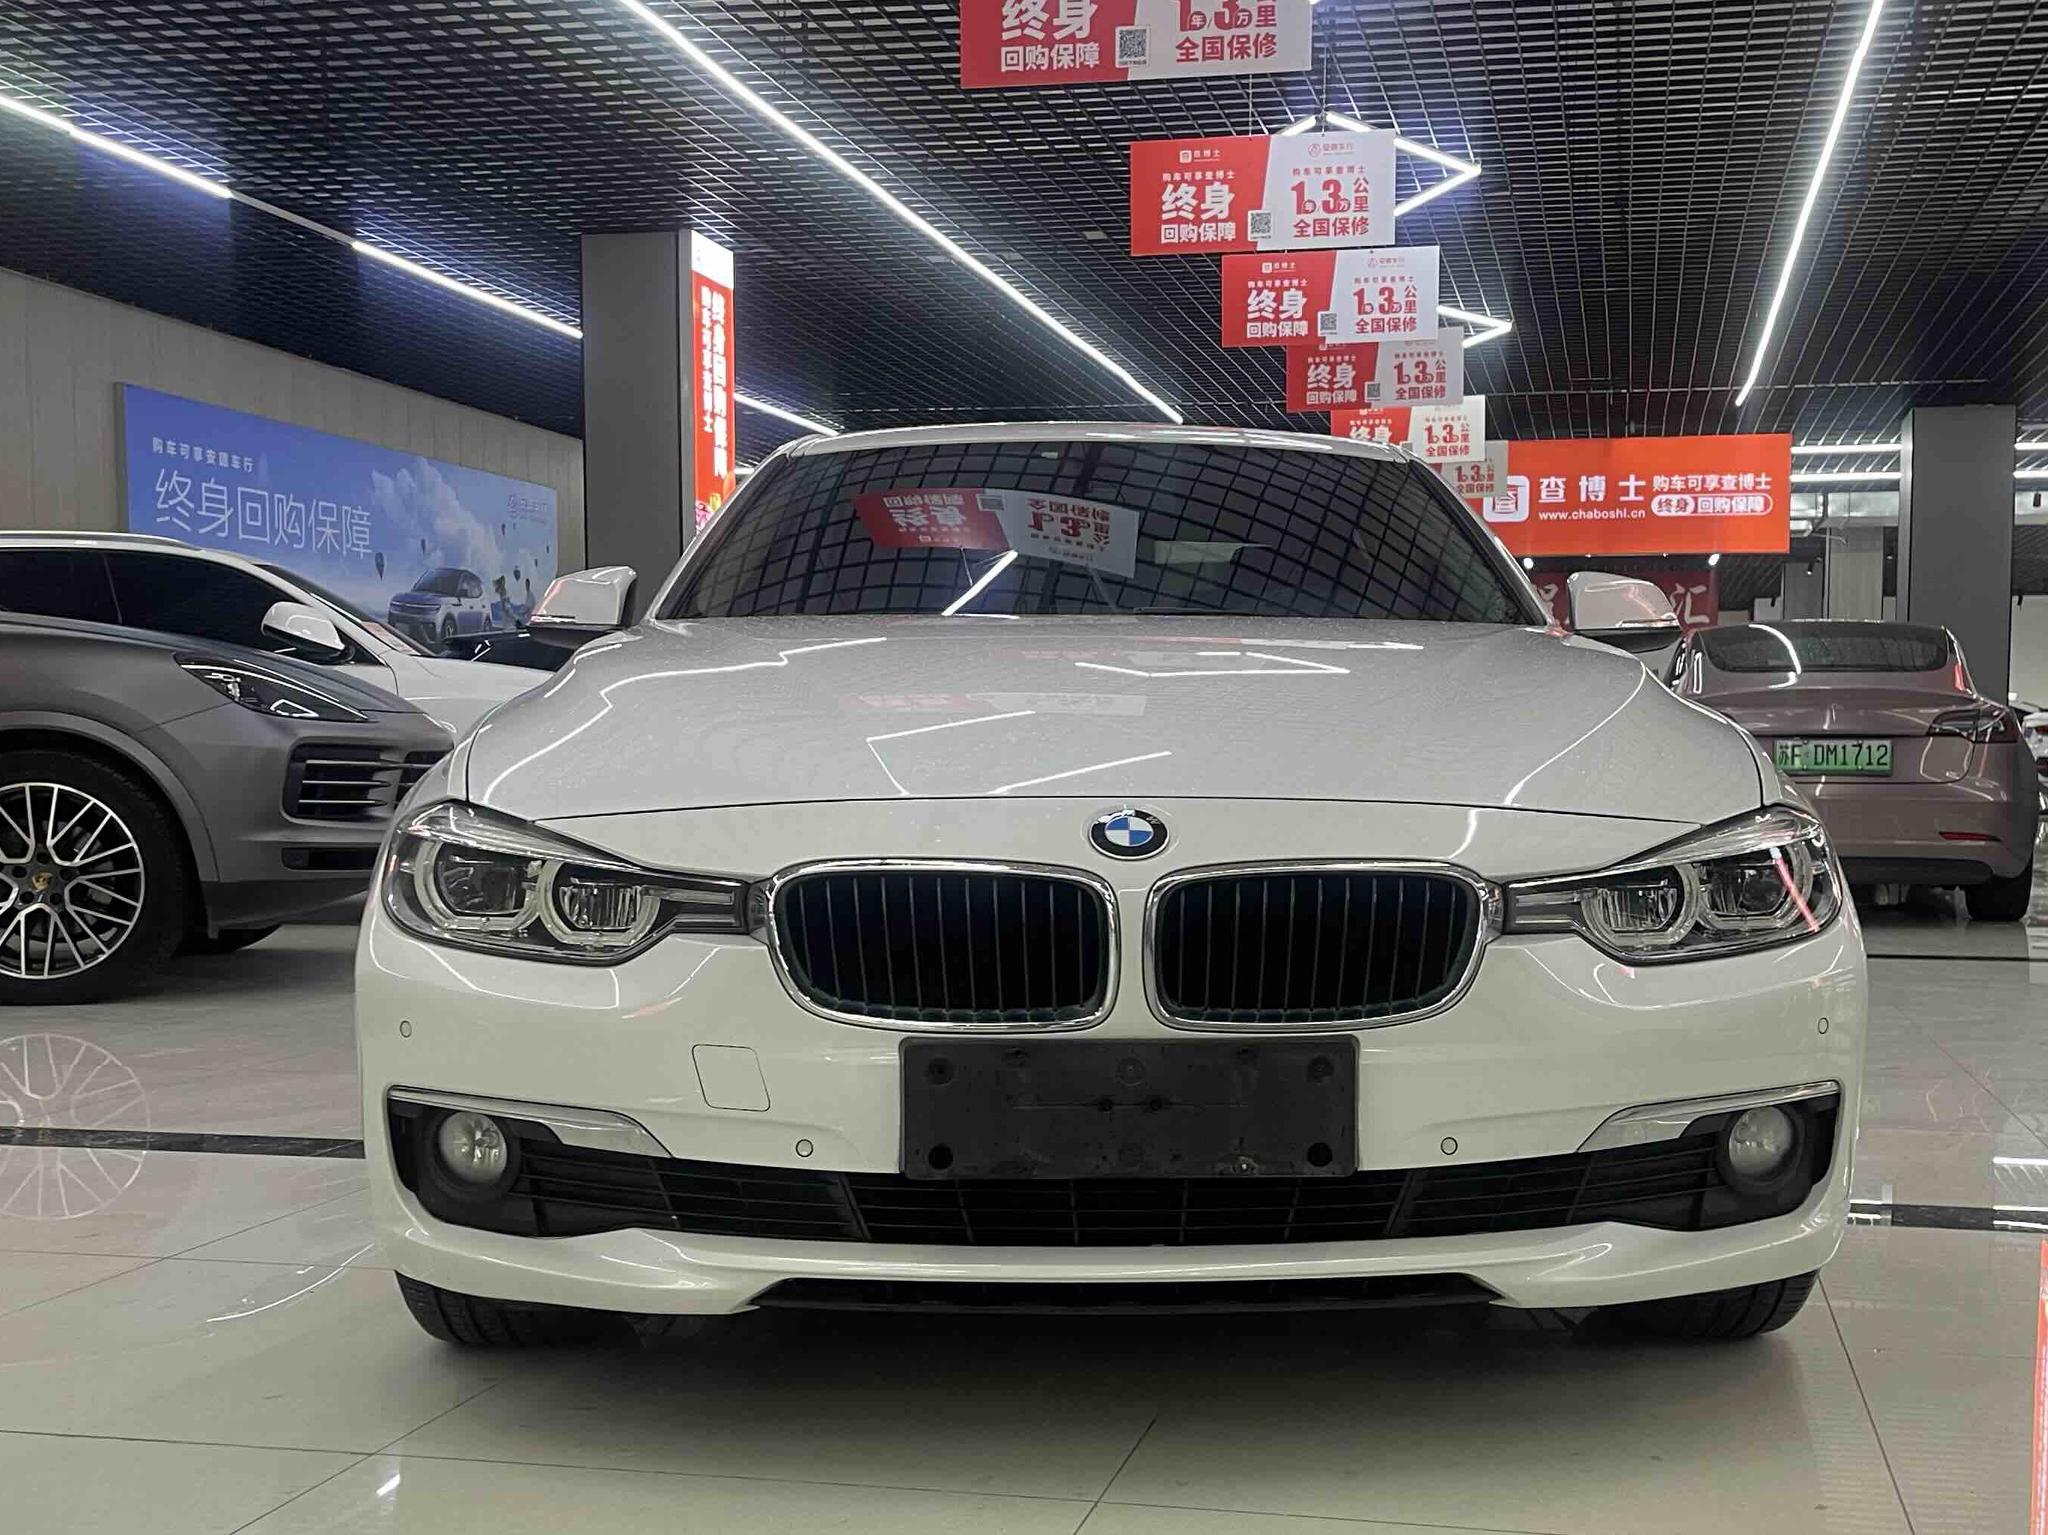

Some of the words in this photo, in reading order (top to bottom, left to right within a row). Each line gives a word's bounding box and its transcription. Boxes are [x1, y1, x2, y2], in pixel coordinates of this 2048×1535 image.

[1001, 0, 1099, 41] 终身
[1000, 43, 1100, 72] 回购保障
[1175, 32, 1278, 63] 全国保修
[1161, 182, 1235, 221] 终身
[1160, 223, 1237, 244] 回购保障
[1293, 216, 1369, 238] 全国保修
[1247, 288, 1308, 320] 终身
[1247, 321, 1309, 339] 回购保障
[1355, 316, 1417, 335] 全国保修
[1306, 363, 1357, 389] 终身
[1306, 389, 1357, 405] 回购保障
[1395, 385, 1446, 401] 全国保修
[1538, 474, 1646, 503] 查博士
[1652, 472, 1772, 492] 购车可享查博士
[155, 467, 373, 559] 终身回购保障
[1539, 508, 1646, 521] www.chaboshi.cn
[1656, 497, 1689, 513] 终身
[1697, 495, 1765, 514] 回购保障
